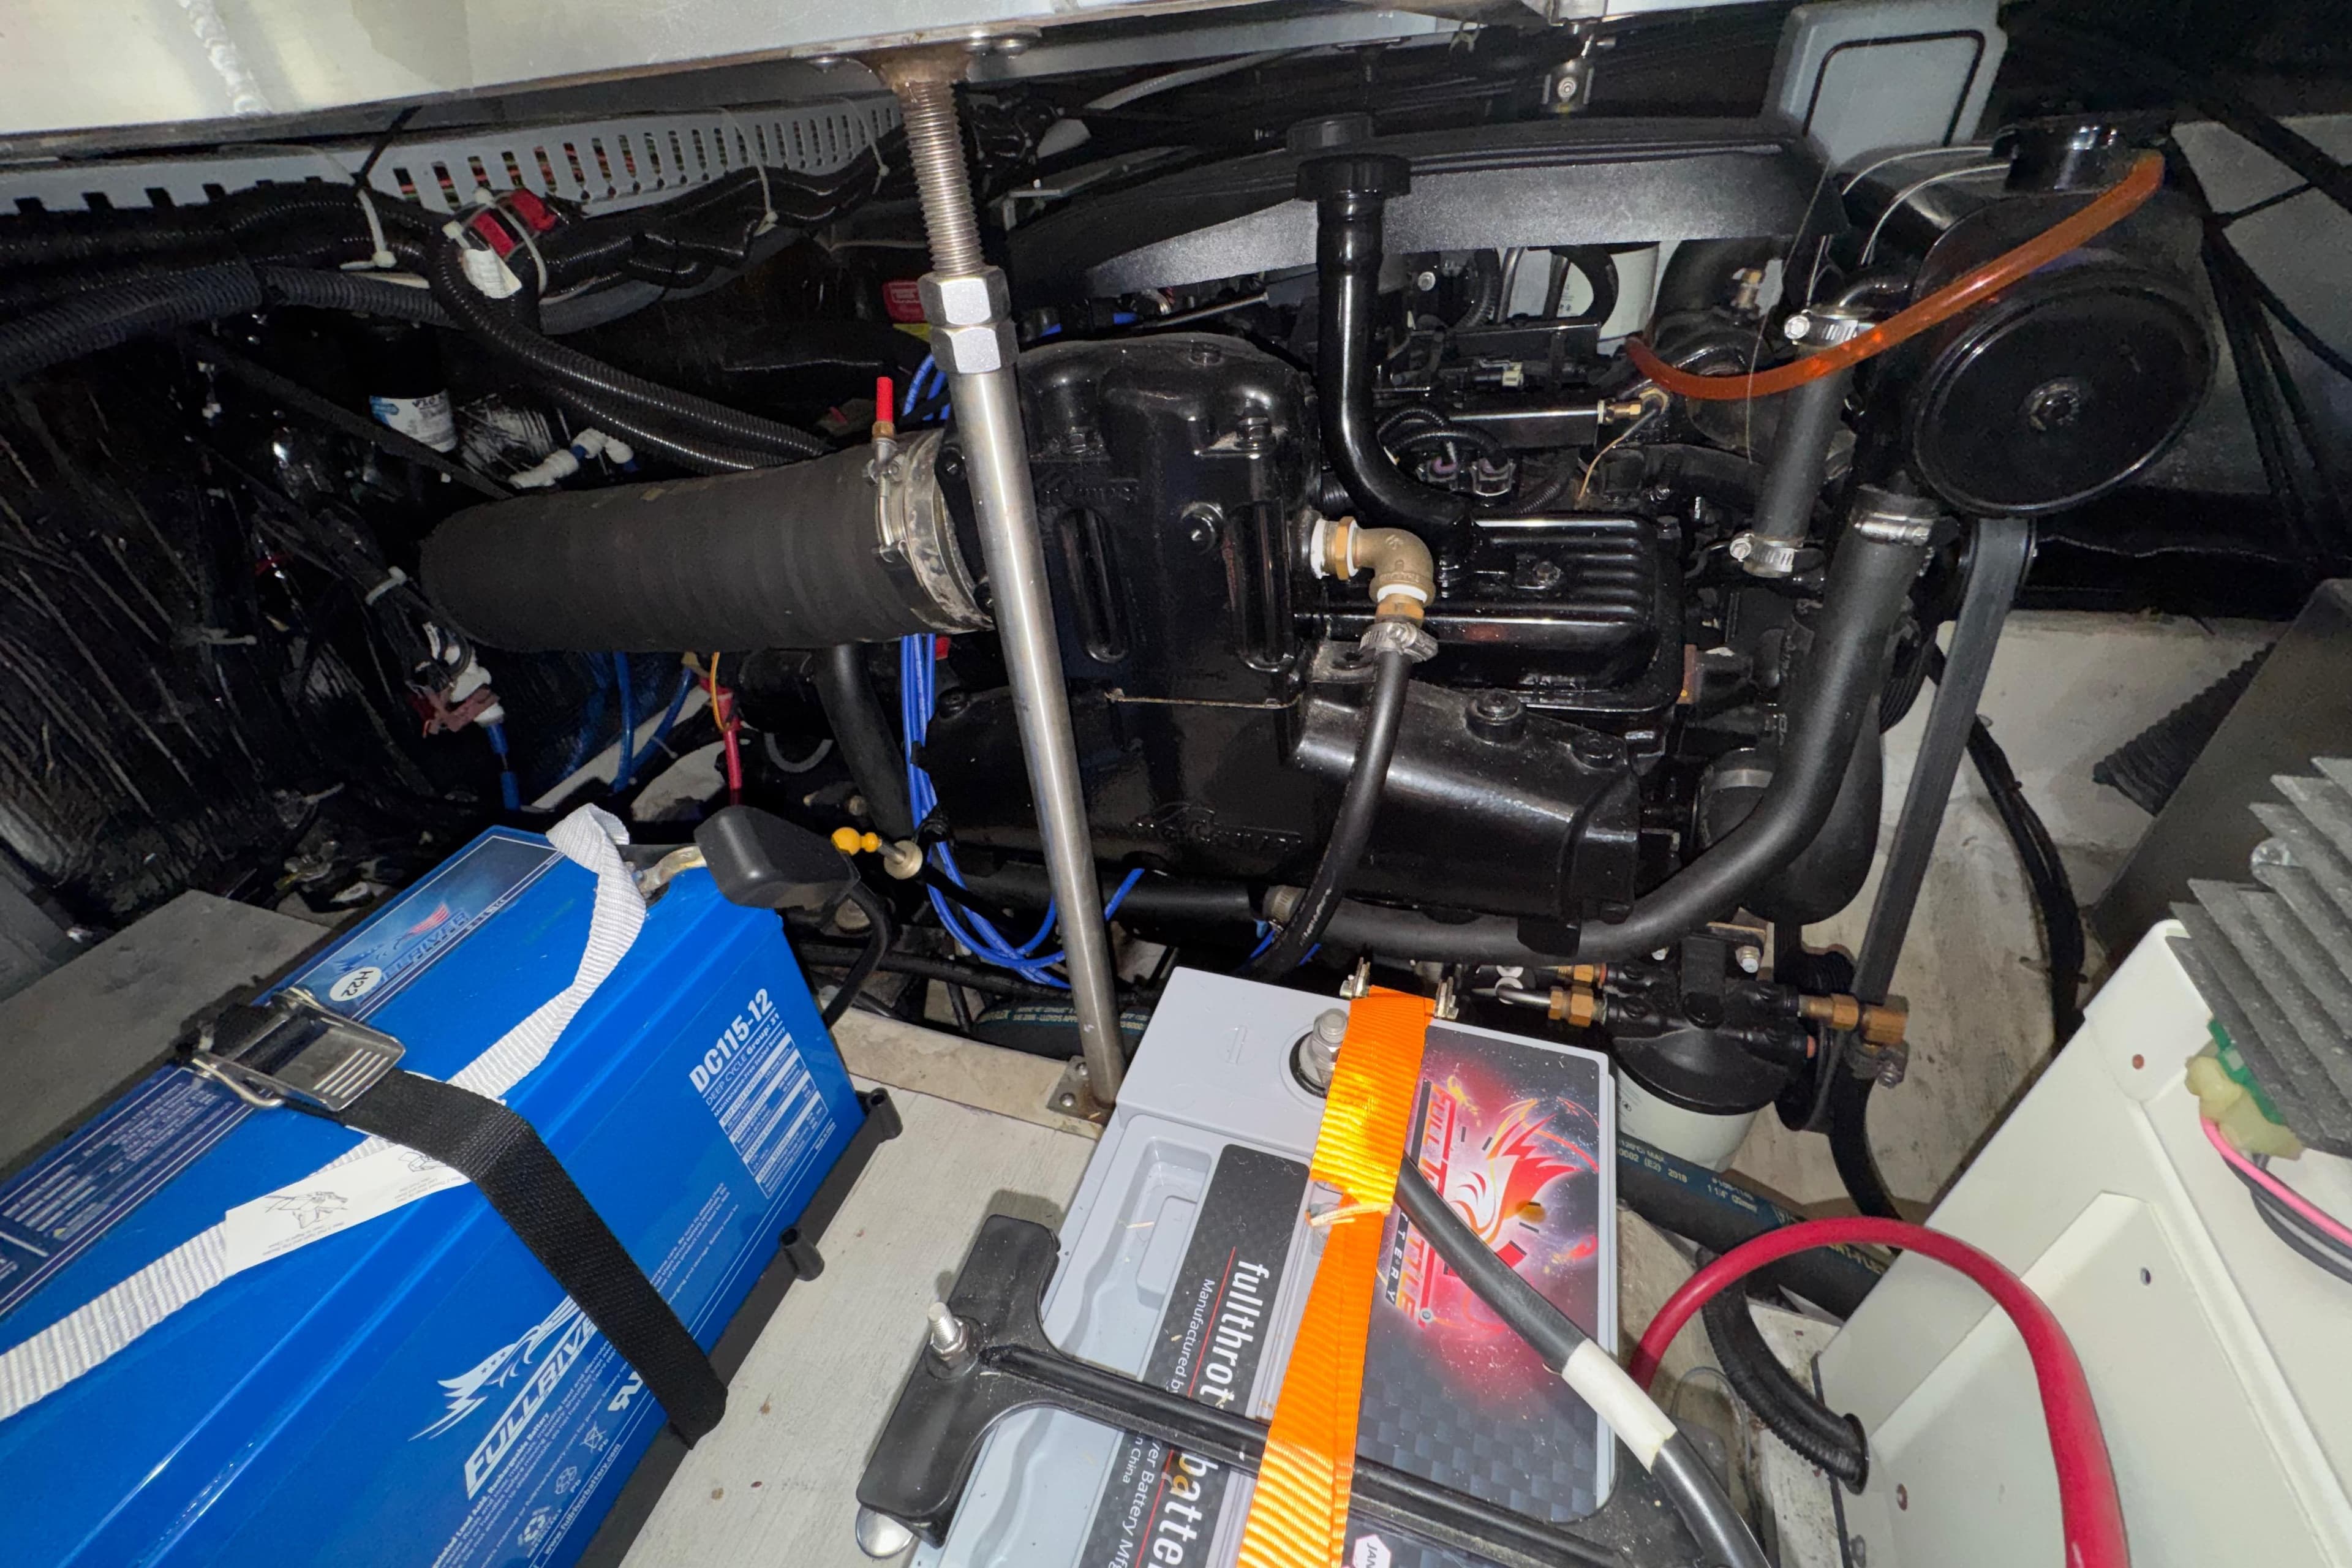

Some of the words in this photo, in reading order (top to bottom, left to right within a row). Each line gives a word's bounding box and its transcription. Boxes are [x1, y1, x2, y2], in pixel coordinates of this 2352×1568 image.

[339, 968, 374, 1000] H22
[688, 985, 774, 1095] DC115-12
[705, 1080, 726, 1107] DEEP
[724, 1052, 748, 1083] CYCLE
[745, 1023, 772, 1056] Group:
[713, 1063, 756, 1118] Maintenance-Free
[1421, 1083, 1455, 1151] FULL
[1172, 1277, 1216, 1378] Manufactured
[1195, 1257, 1273, 1411] fullthrot
[464, 1314, 597, 1490] FULLRIVE
[455, 1514, 474, 1537] Lead
[486, 1439, 530, 1494] Rechargeable
[526, 1411, 551, 1441] Battery
[1120, 1446, 1143, 1485] China
[1122, 1470, 1155, 1536] Battery
[1147, 1452, 1219, 1568] batte
